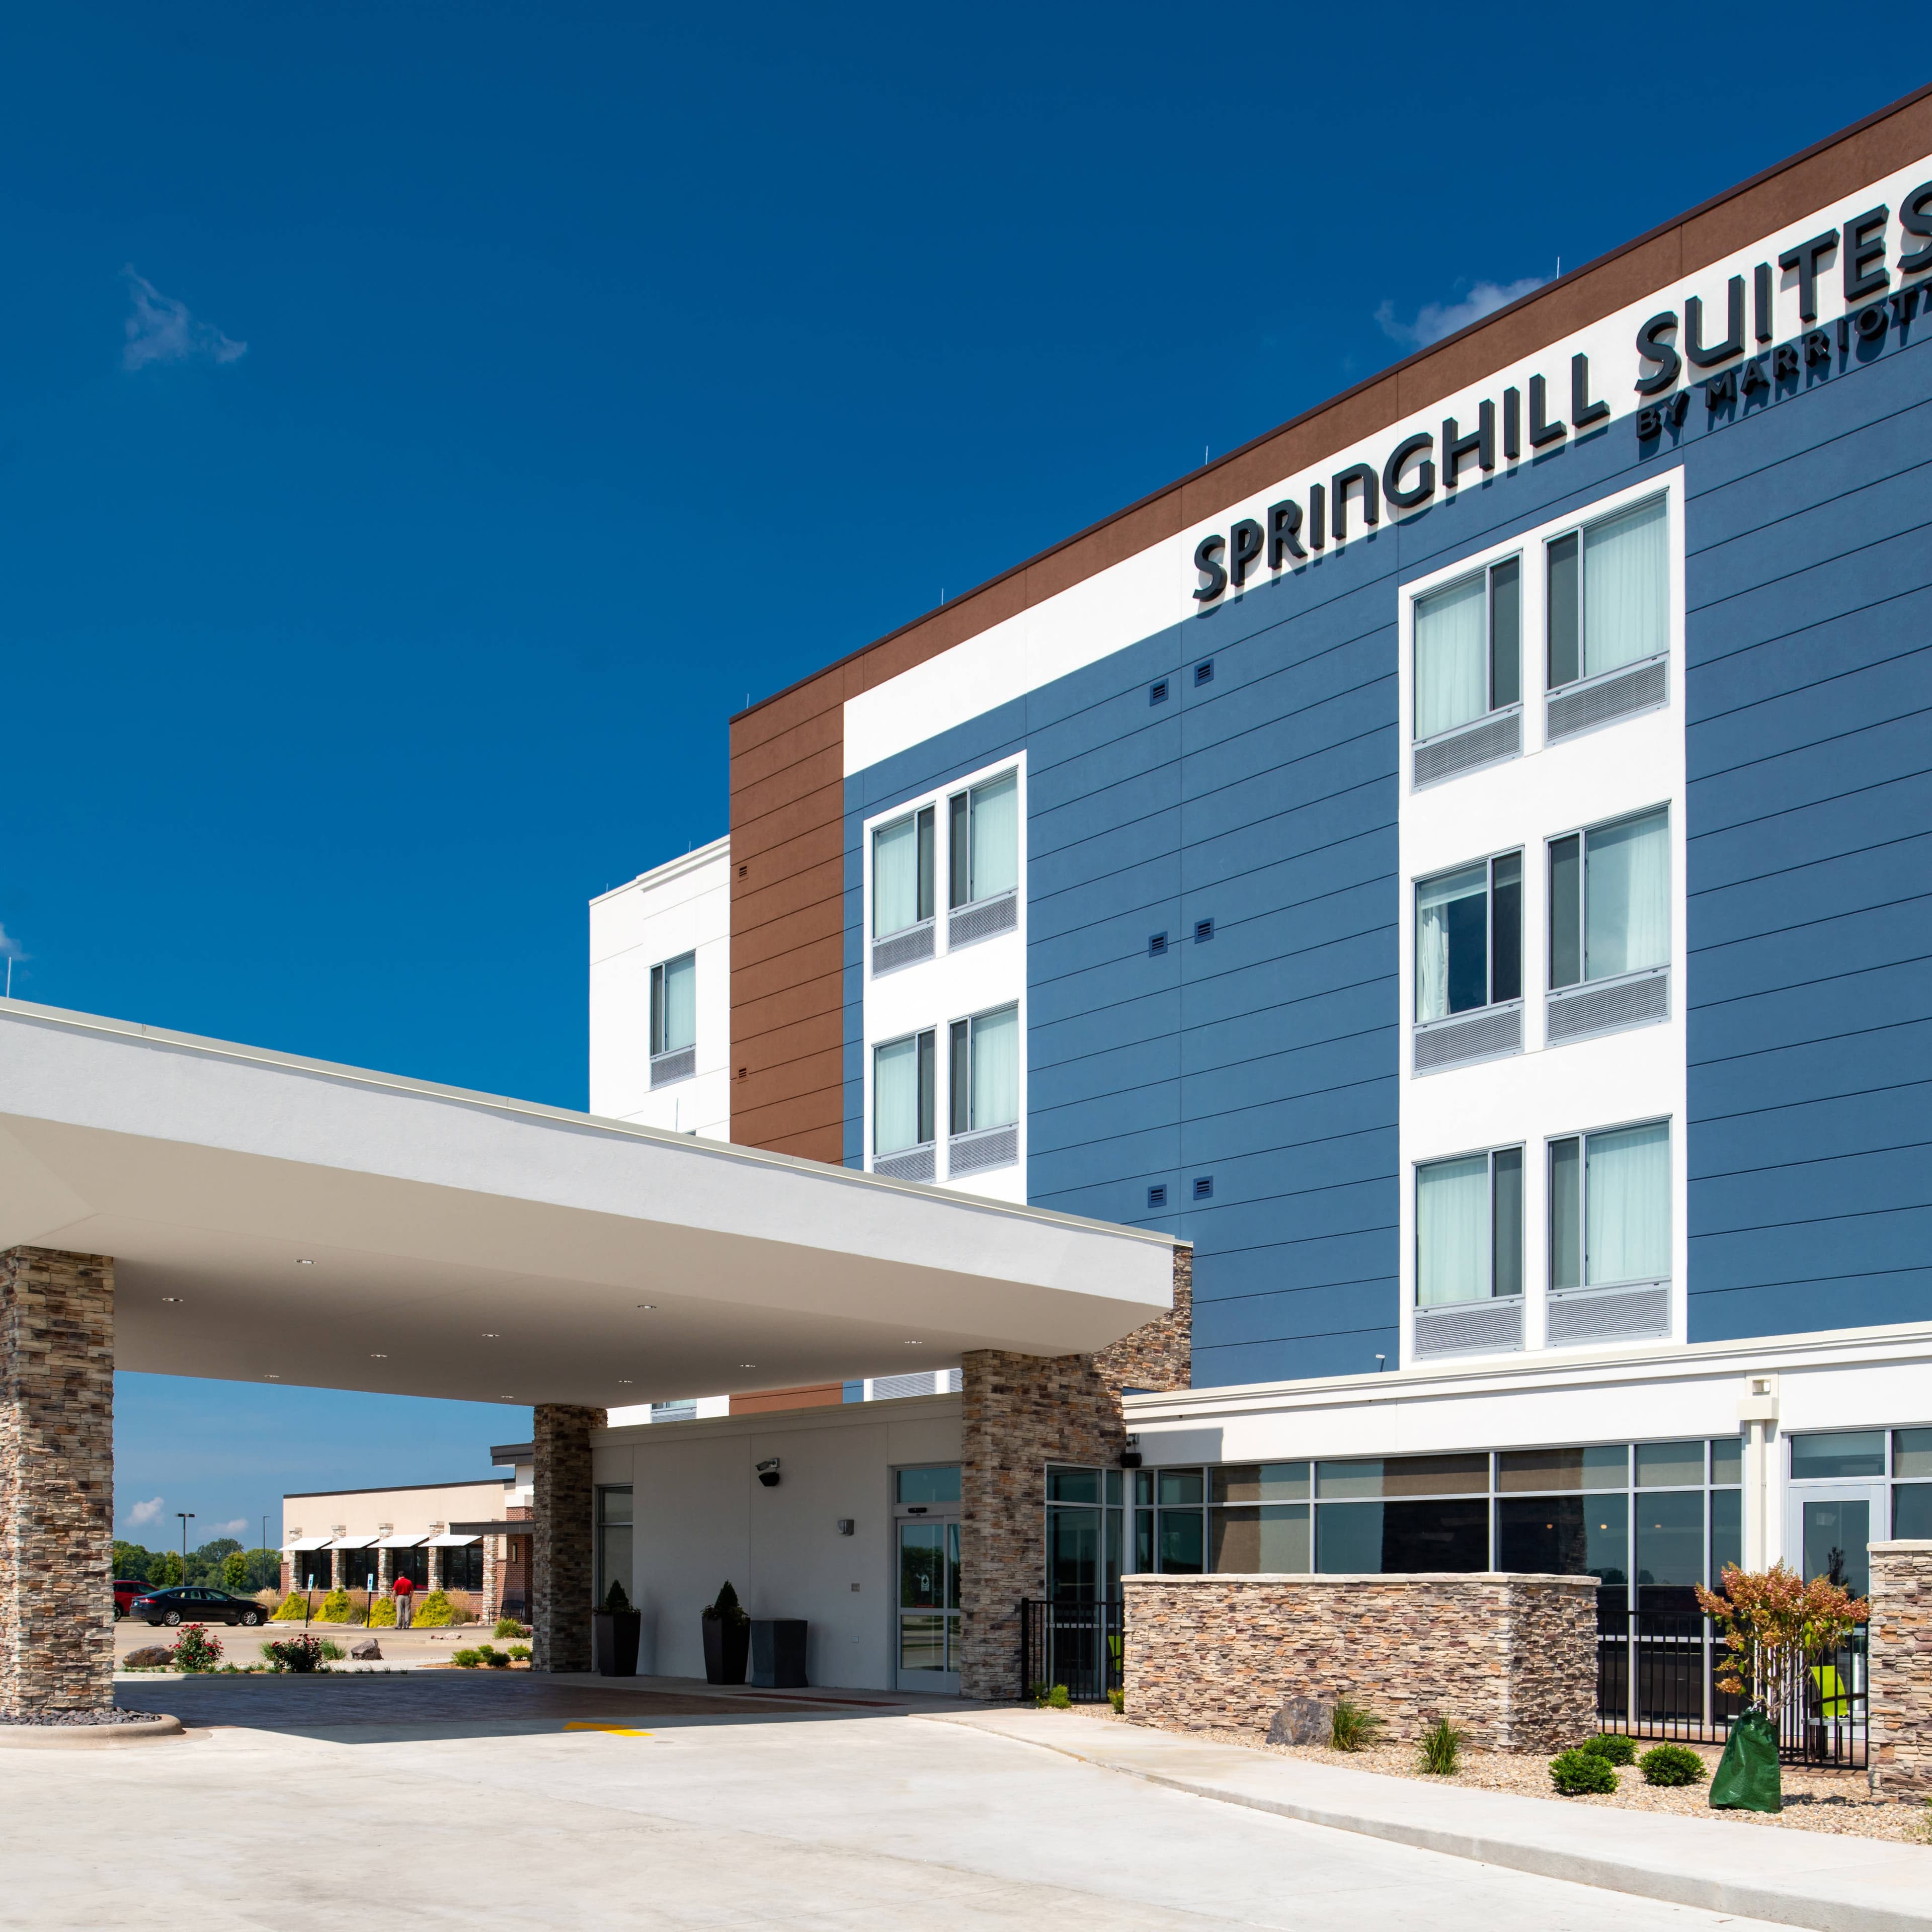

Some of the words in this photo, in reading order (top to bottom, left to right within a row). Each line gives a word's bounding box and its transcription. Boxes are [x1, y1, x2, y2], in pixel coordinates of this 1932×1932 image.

[1192, 352, 1610, 602] SPRINGHILL
[1634, 180, 1932, 396] SUITES
[1636, 390, 1690, 442] BY
